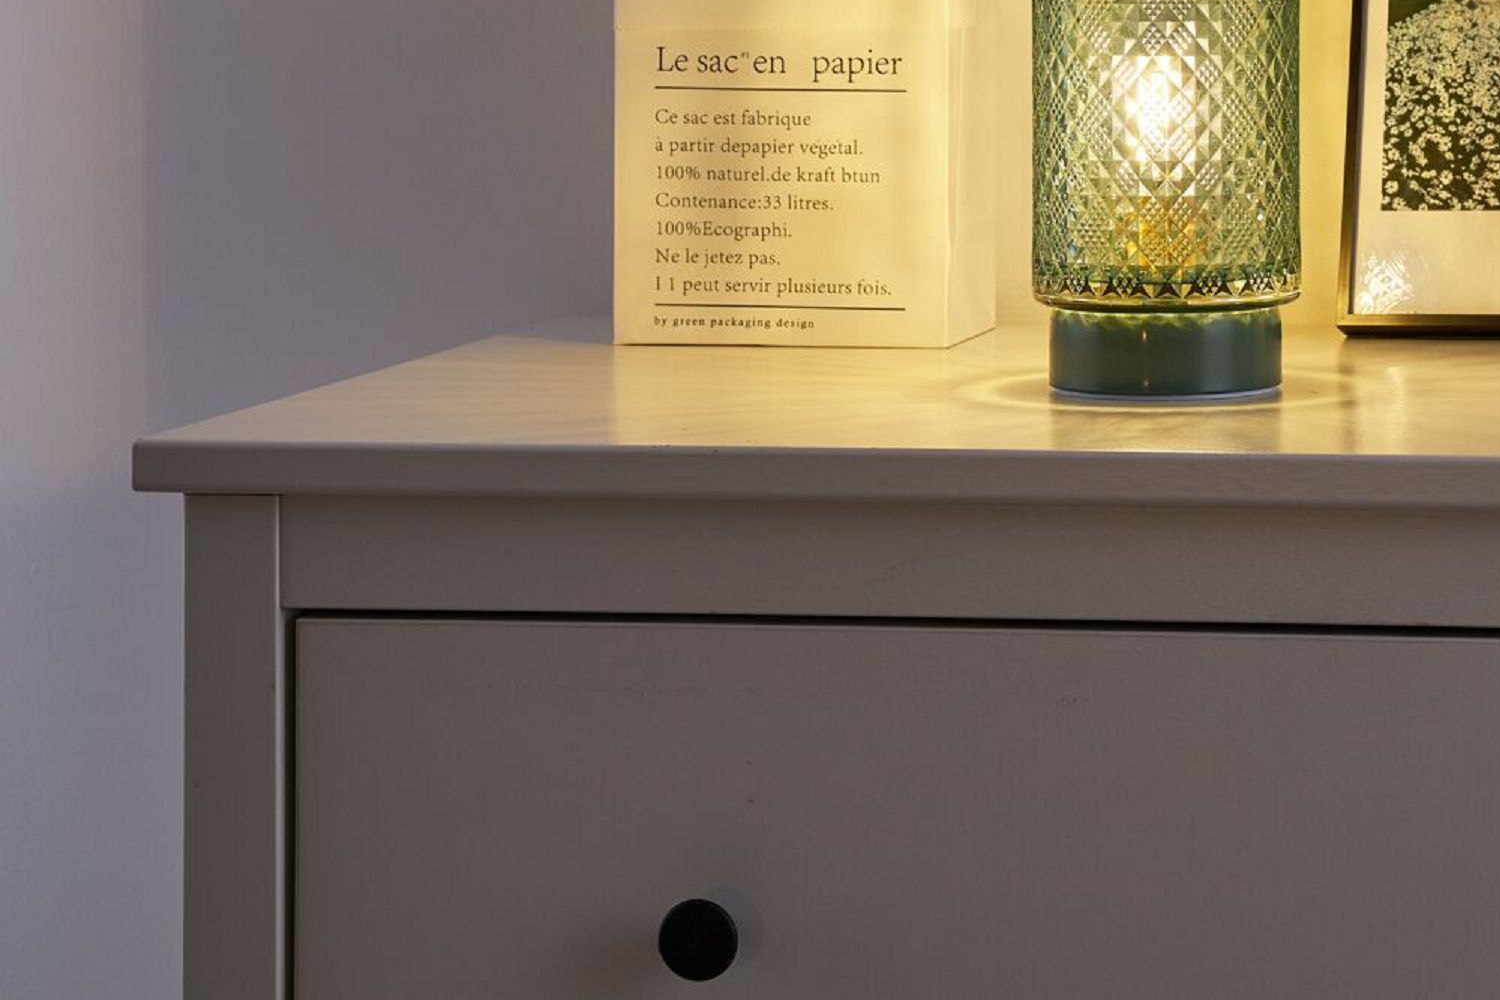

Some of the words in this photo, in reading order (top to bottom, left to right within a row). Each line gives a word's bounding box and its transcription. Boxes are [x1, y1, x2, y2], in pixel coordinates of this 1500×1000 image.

[656, 46, 690, 73] Le
[811, 48, 903, 84] papier
[655, 108, 679, 125] Ce
[683, 112, 709, 125] sac
[713, 111, 736, 126] est
[741, 109, 812, 131] fabrique
[669, 137, 717, 158] partir
[656, 164, 702, 181] 100%
[796, 165, 837, 183] kraft
[787, 193, 835, 211] litres.
[655, 248, 681, 265] Ne
[685, 248, 700, 265] le
[704, 248, 743, 268] jetez
[748, 252, 781, 269] pas.
[682, 277, 720, 297] peut
[725, 277, 773, 294] servir
[776, 277, 853, 298] plusieurs
[857, 278, 893, 296] fois.
[653, 315, 669, 328] by
[672, 317, 707, 328] green
[710, 315, 772, 330] packaging
[775, 316, 815, 330] design
